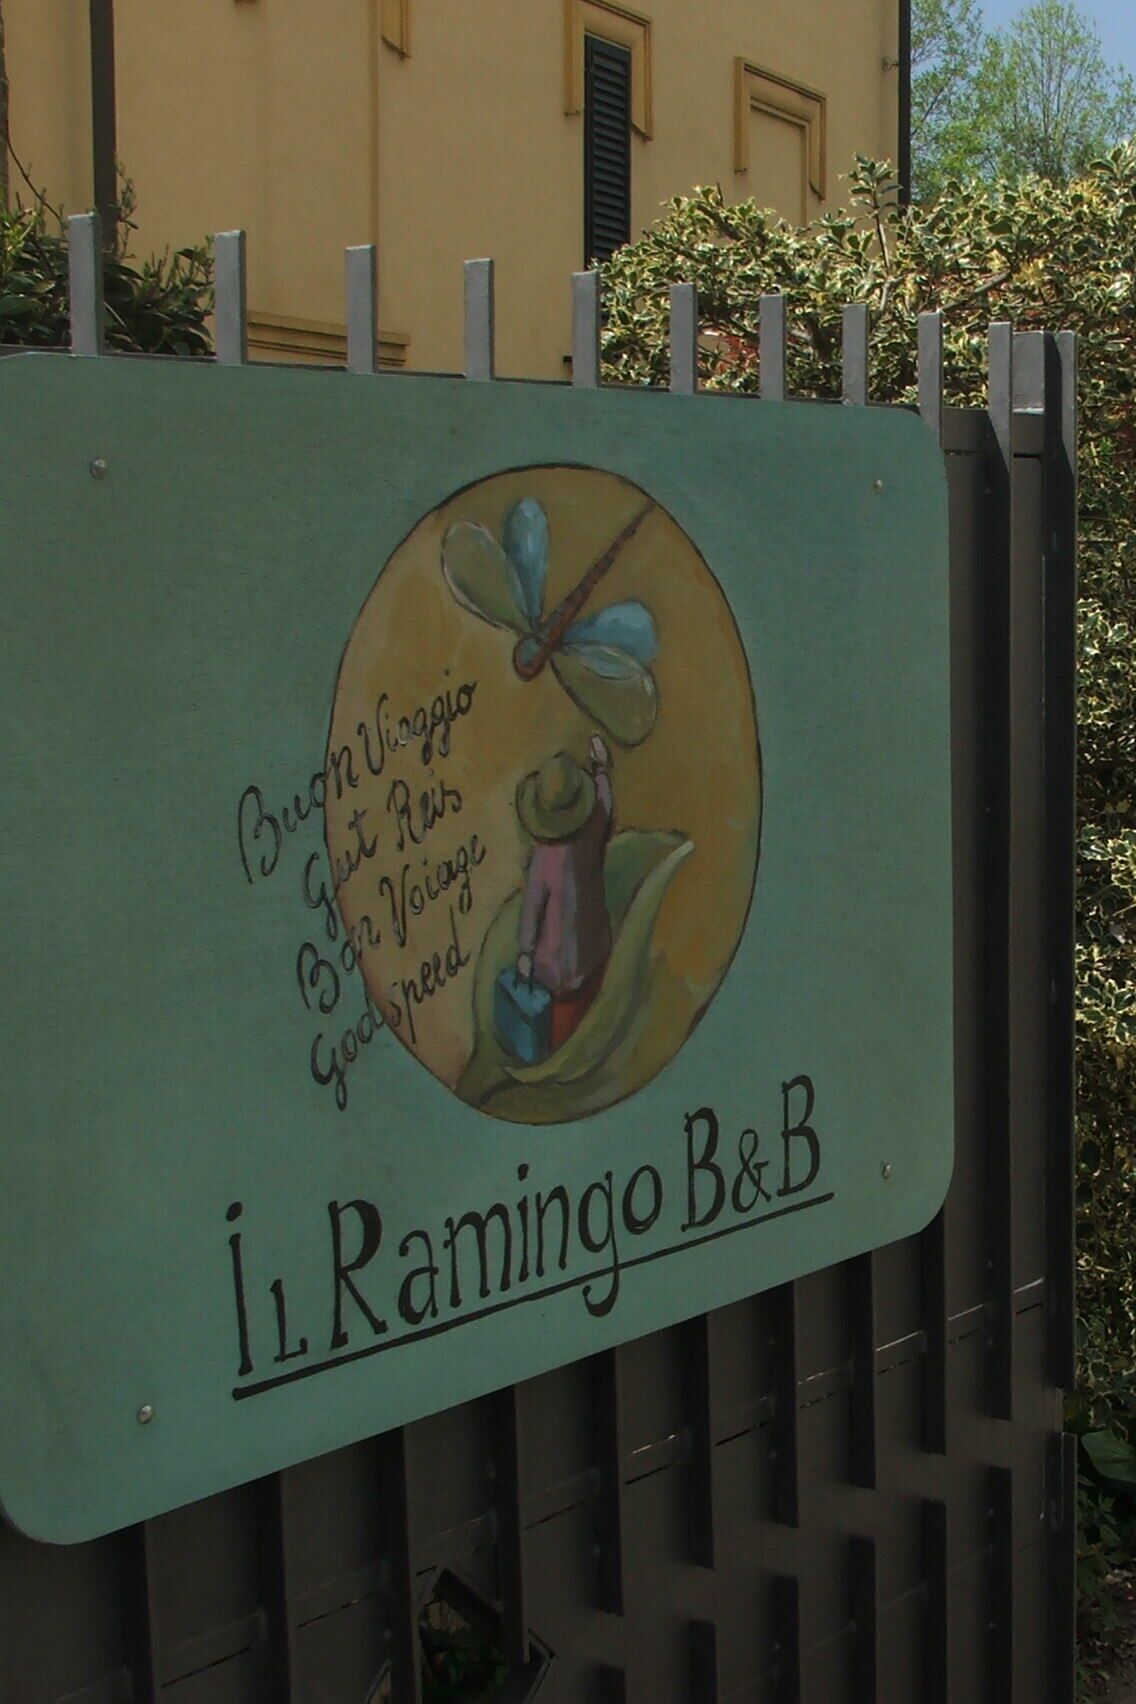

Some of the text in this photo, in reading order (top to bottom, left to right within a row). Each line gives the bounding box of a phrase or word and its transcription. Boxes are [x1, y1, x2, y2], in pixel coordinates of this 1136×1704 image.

[239, 668, 477, 884] Buon Viaggio
[303, 809, 378, 940] Gut
[297, 915, 381, 1014] Bon
[328, 1164, 663, 1349] Ramingo
[681, 1074, 821, 1232] B&B
